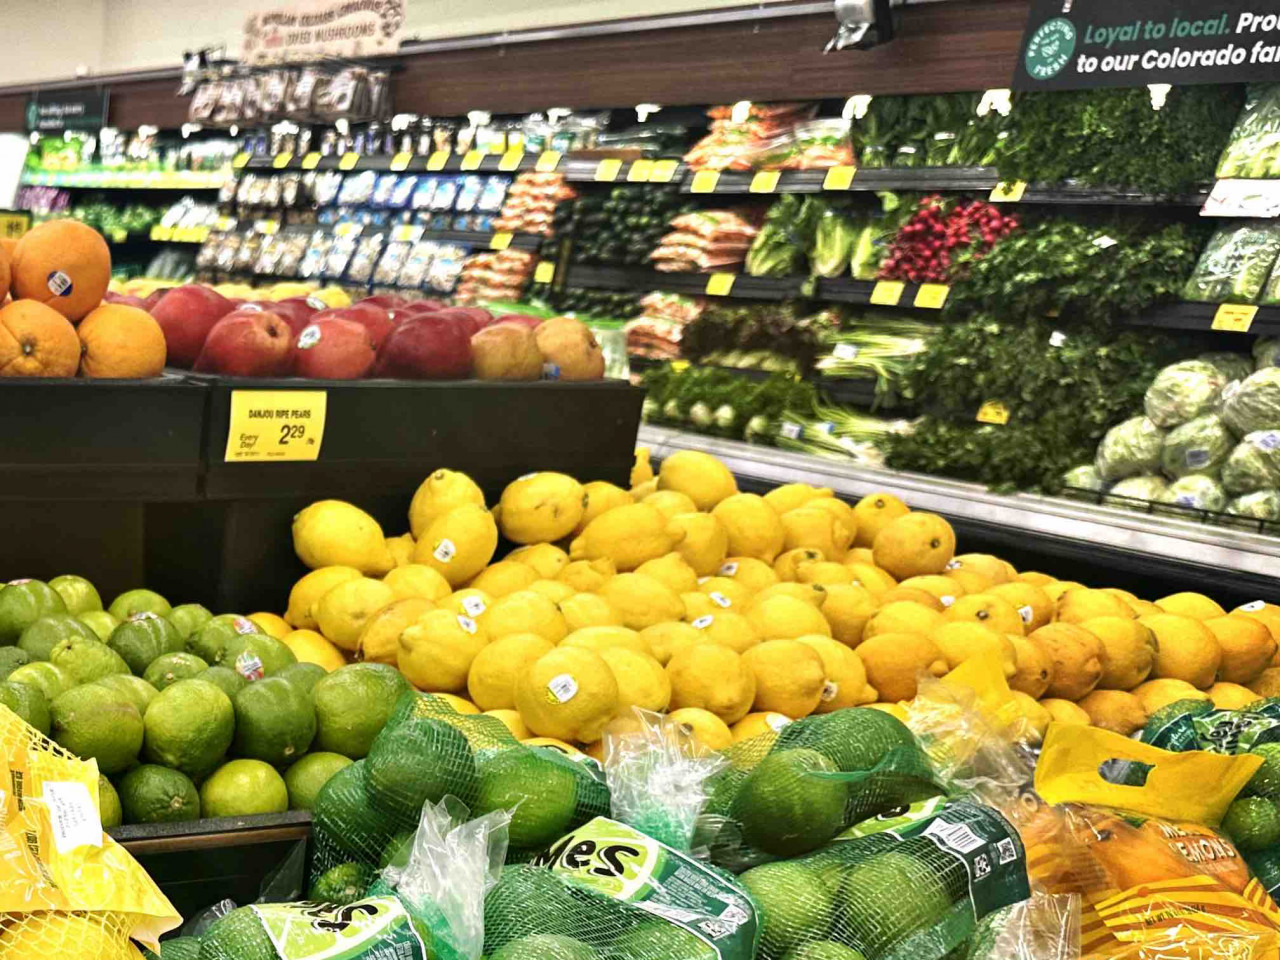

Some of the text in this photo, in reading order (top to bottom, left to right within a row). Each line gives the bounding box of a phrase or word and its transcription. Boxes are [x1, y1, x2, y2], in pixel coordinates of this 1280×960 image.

[1028, 20, 1074, 57] PERFECTING
[1084, 13, 1230, 49] Loyal to local.
[1034, 53, 1068, 77] FRESH
[1076, 43, 1247, 74] to our Colorado
[275, 409, 290, 419] RIPE
[291, 409, 311, 419] PEARS
